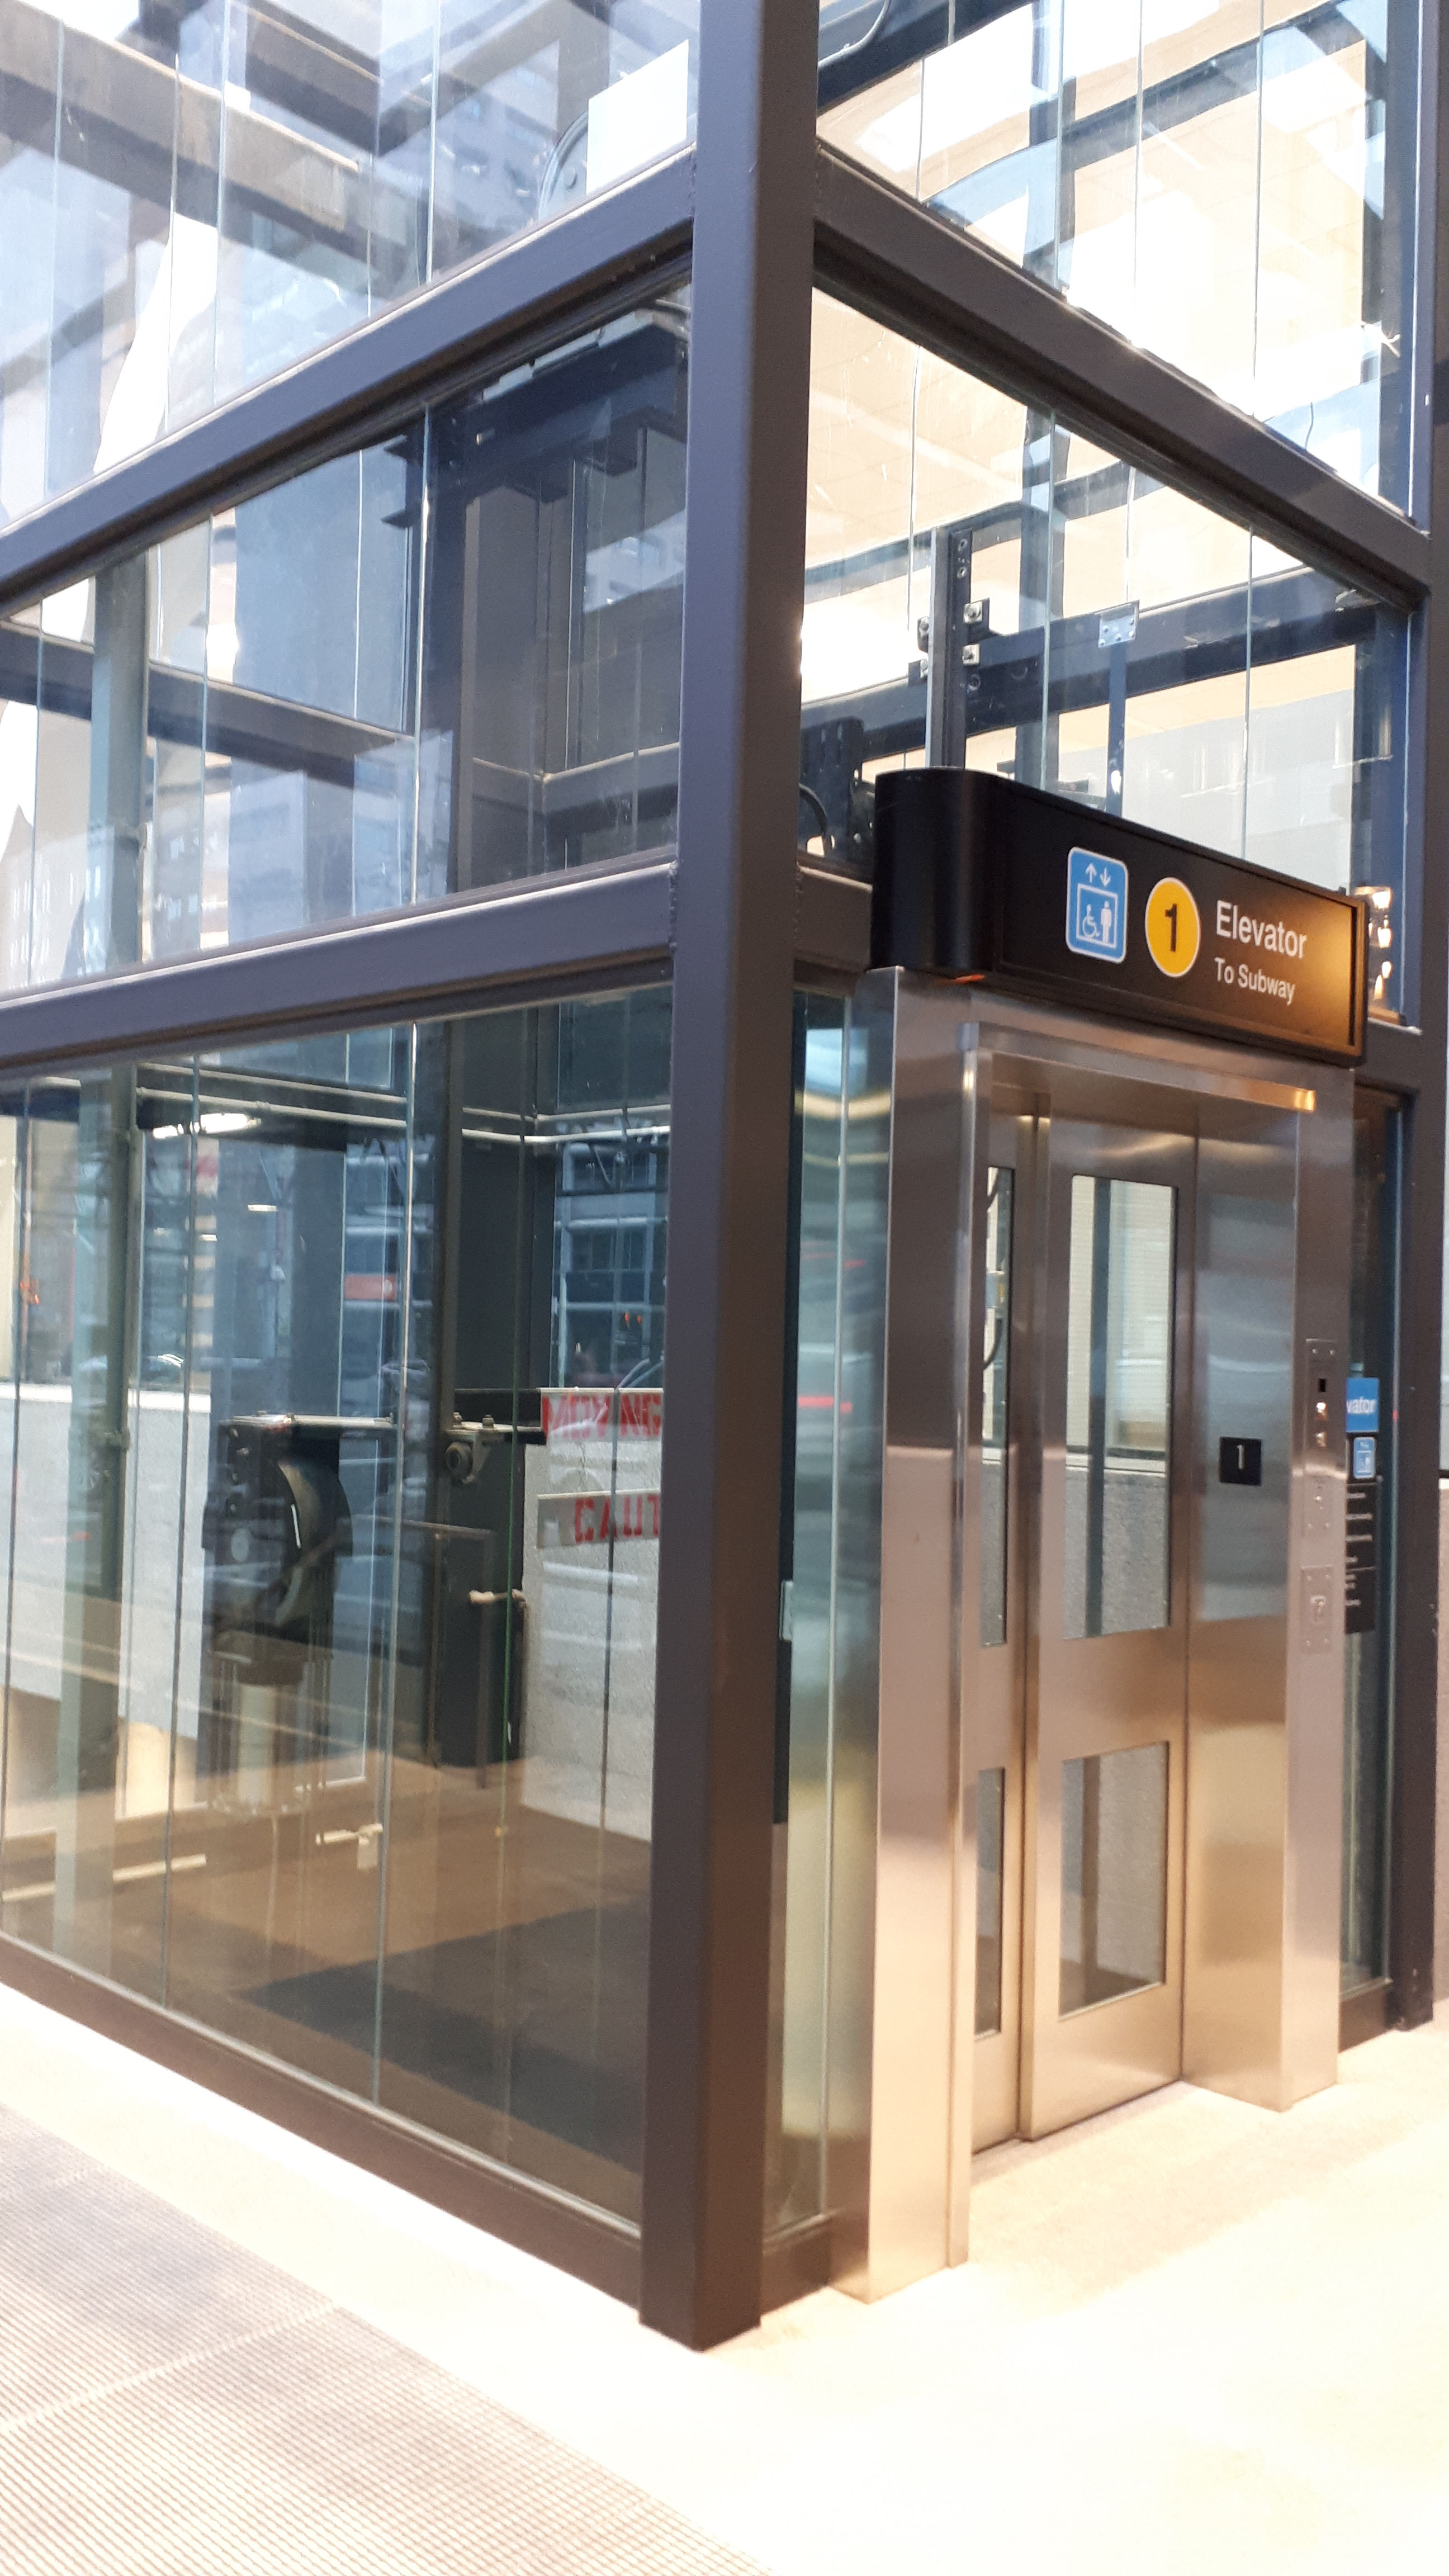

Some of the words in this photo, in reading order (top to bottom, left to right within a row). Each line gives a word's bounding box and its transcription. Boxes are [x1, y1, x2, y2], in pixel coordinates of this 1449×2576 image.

[1164, 903, 1177, 953] 1
[1216, 899, 1308, 959] Elevator
[1214, 956, 1234, 984] To
[1238, 963, 1296, 1006] Subway
[541, 1394, 662, 1445] MOVNG
[1236, 1444, 1244, 1470] 1
